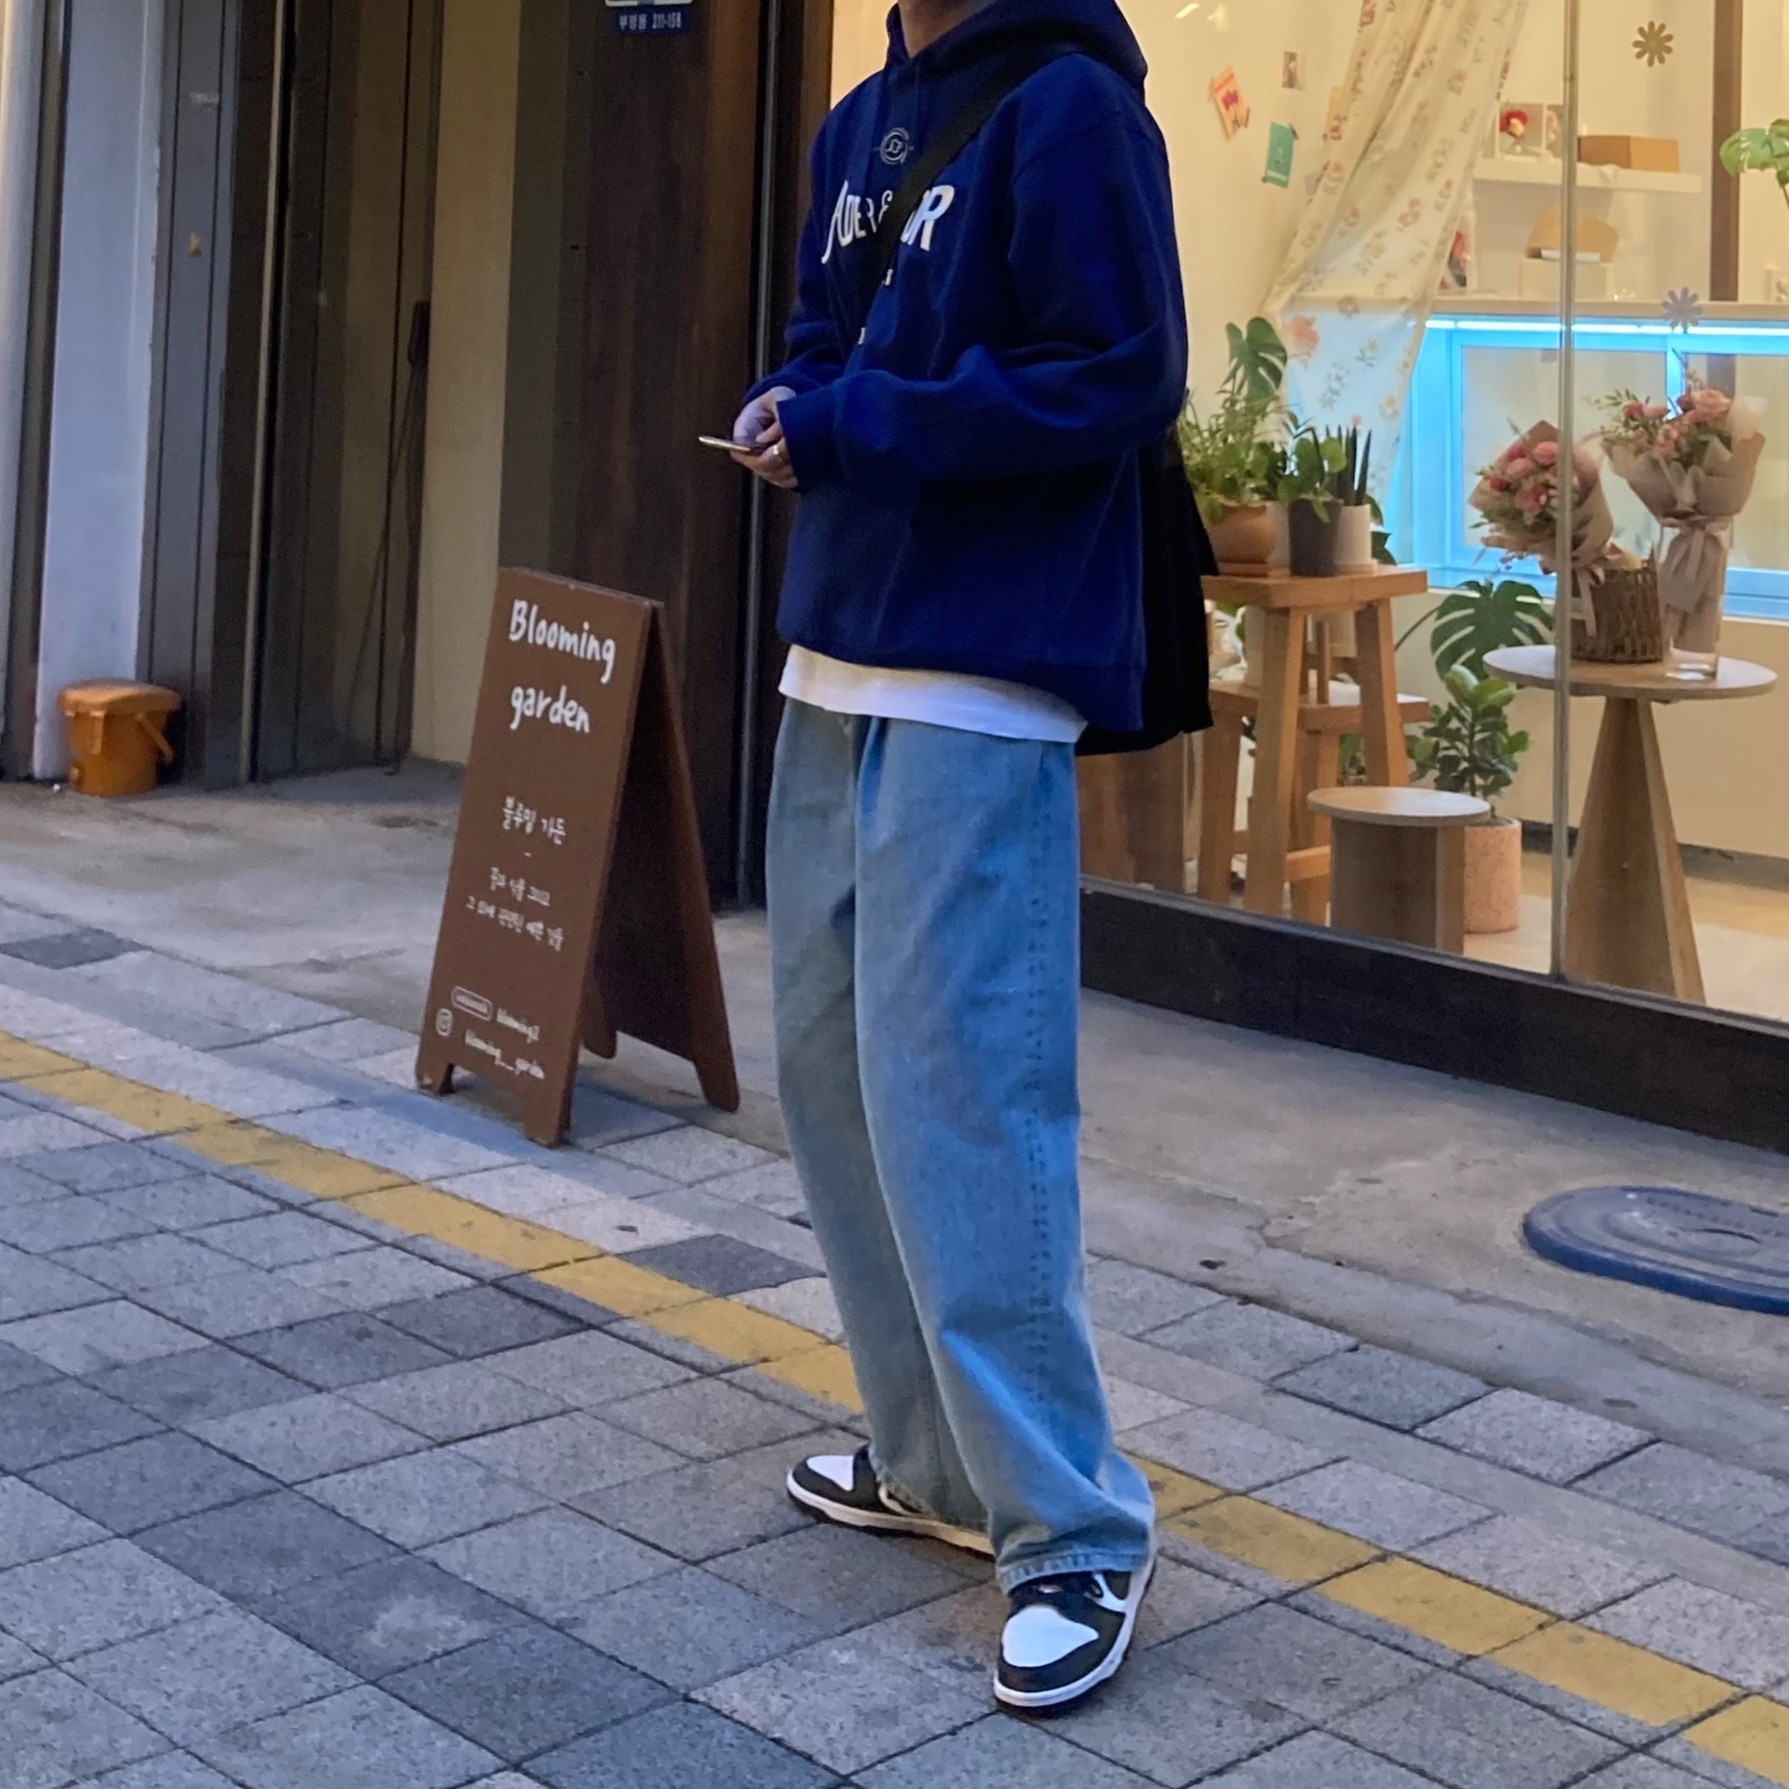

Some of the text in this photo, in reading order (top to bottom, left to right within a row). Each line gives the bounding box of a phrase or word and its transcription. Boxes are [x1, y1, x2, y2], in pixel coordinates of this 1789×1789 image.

[508, 599, 616, 684] Blooming
[510, 684, 590, 733] garden
[502, 795, 566, 845] 블루밍 가든
